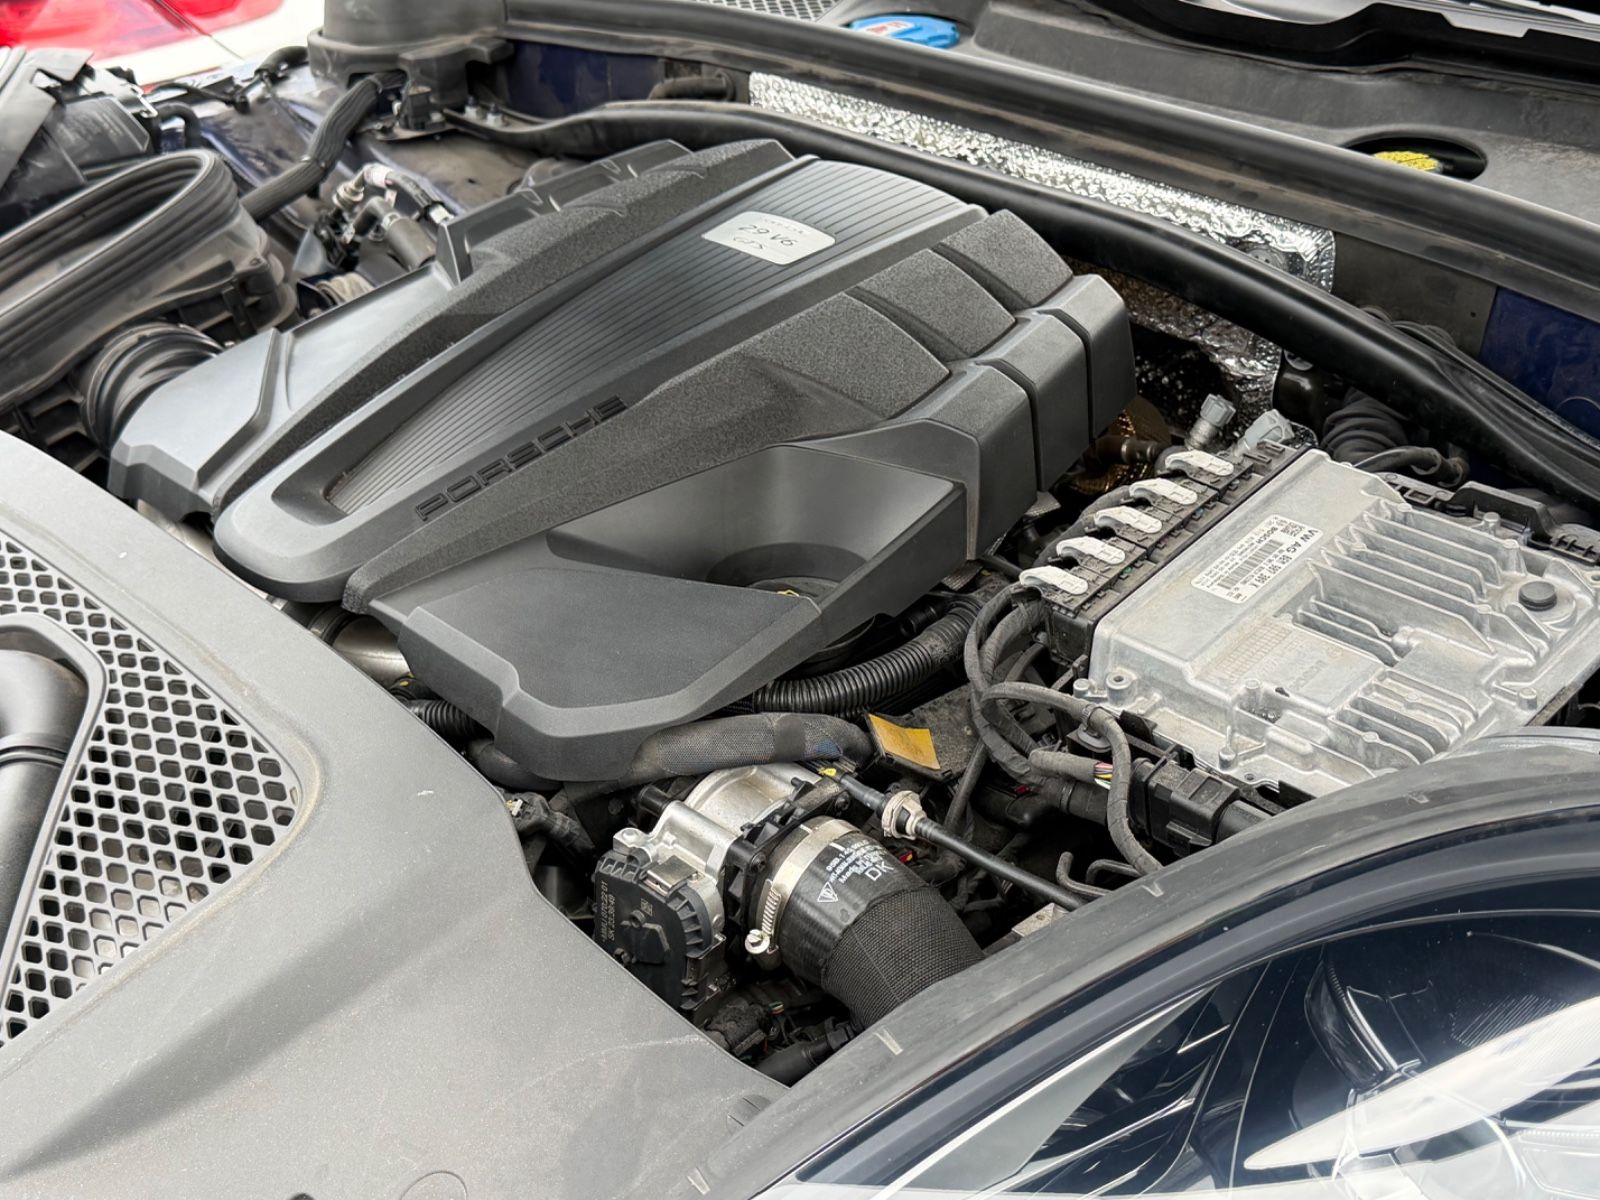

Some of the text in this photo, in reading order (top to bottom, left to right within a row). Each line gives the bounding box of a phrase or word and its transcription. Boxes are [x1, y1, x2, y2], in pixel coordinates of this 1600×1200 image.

[415, 395, 628, 521] PORSCHE
[1300, 529, 1319, 542] VW
[1286, 541, 1302, 554] AG
[864, 860, 895, 882] DK
